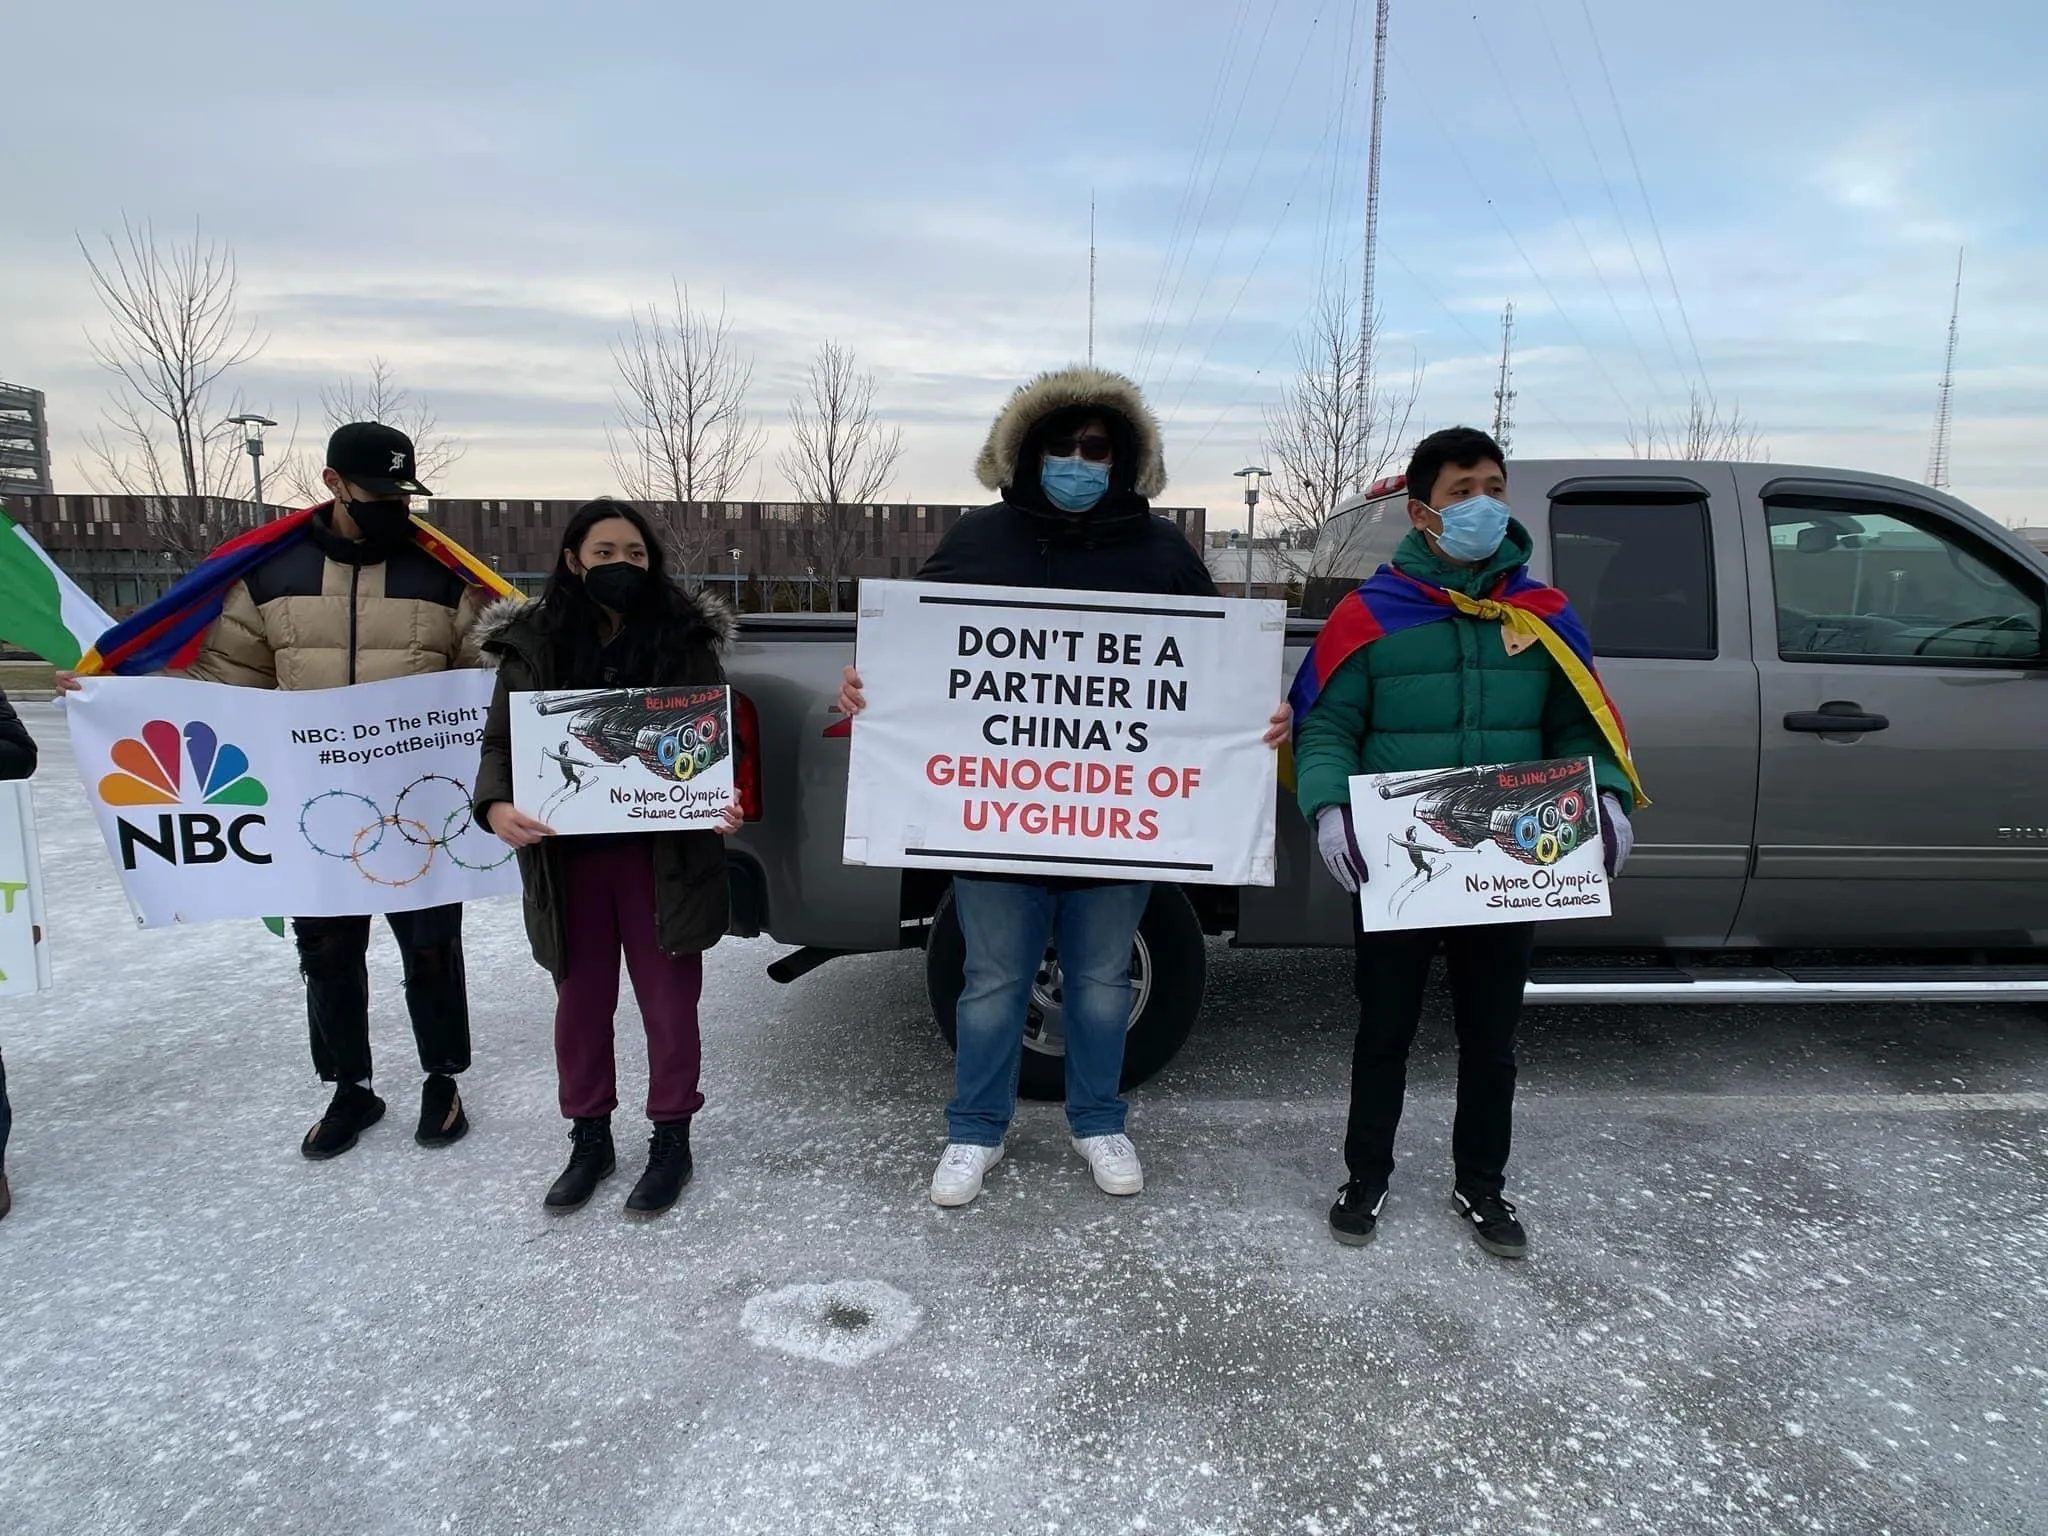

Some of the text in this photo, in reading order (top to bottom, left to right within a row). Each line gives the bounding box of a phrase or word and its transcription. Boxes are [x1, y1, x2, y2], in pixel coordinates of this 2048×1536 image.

[958, 625, 1185, 668] DON'T BE A
[645, 689, 722, 710] BEIJING 2022
[948, 668, 1188, 712] PARTNER IN
[291, 728, 346, 744] NBC:
[353, 724, 380, 740] Do
[385, 717, 421, 733] The
[427, 707, 478, 726] Right
[982, 713, 1149, 753] CHINA'S
[926, 754, 1201, 799] GENOCIDE OF
[1496, 762, 1585, 788] BEIJING 2022
[610, 784, 730, 807] No More Olympic
[627, 805, 727, 819] Shame Games
[963, 799, 1159, 841] UYGHURS
[116, 813, 273, 870] NBC
[1465, 869, 1602, 892] No More Olympic
[1486, 892, 1601, 908] Shame Games
